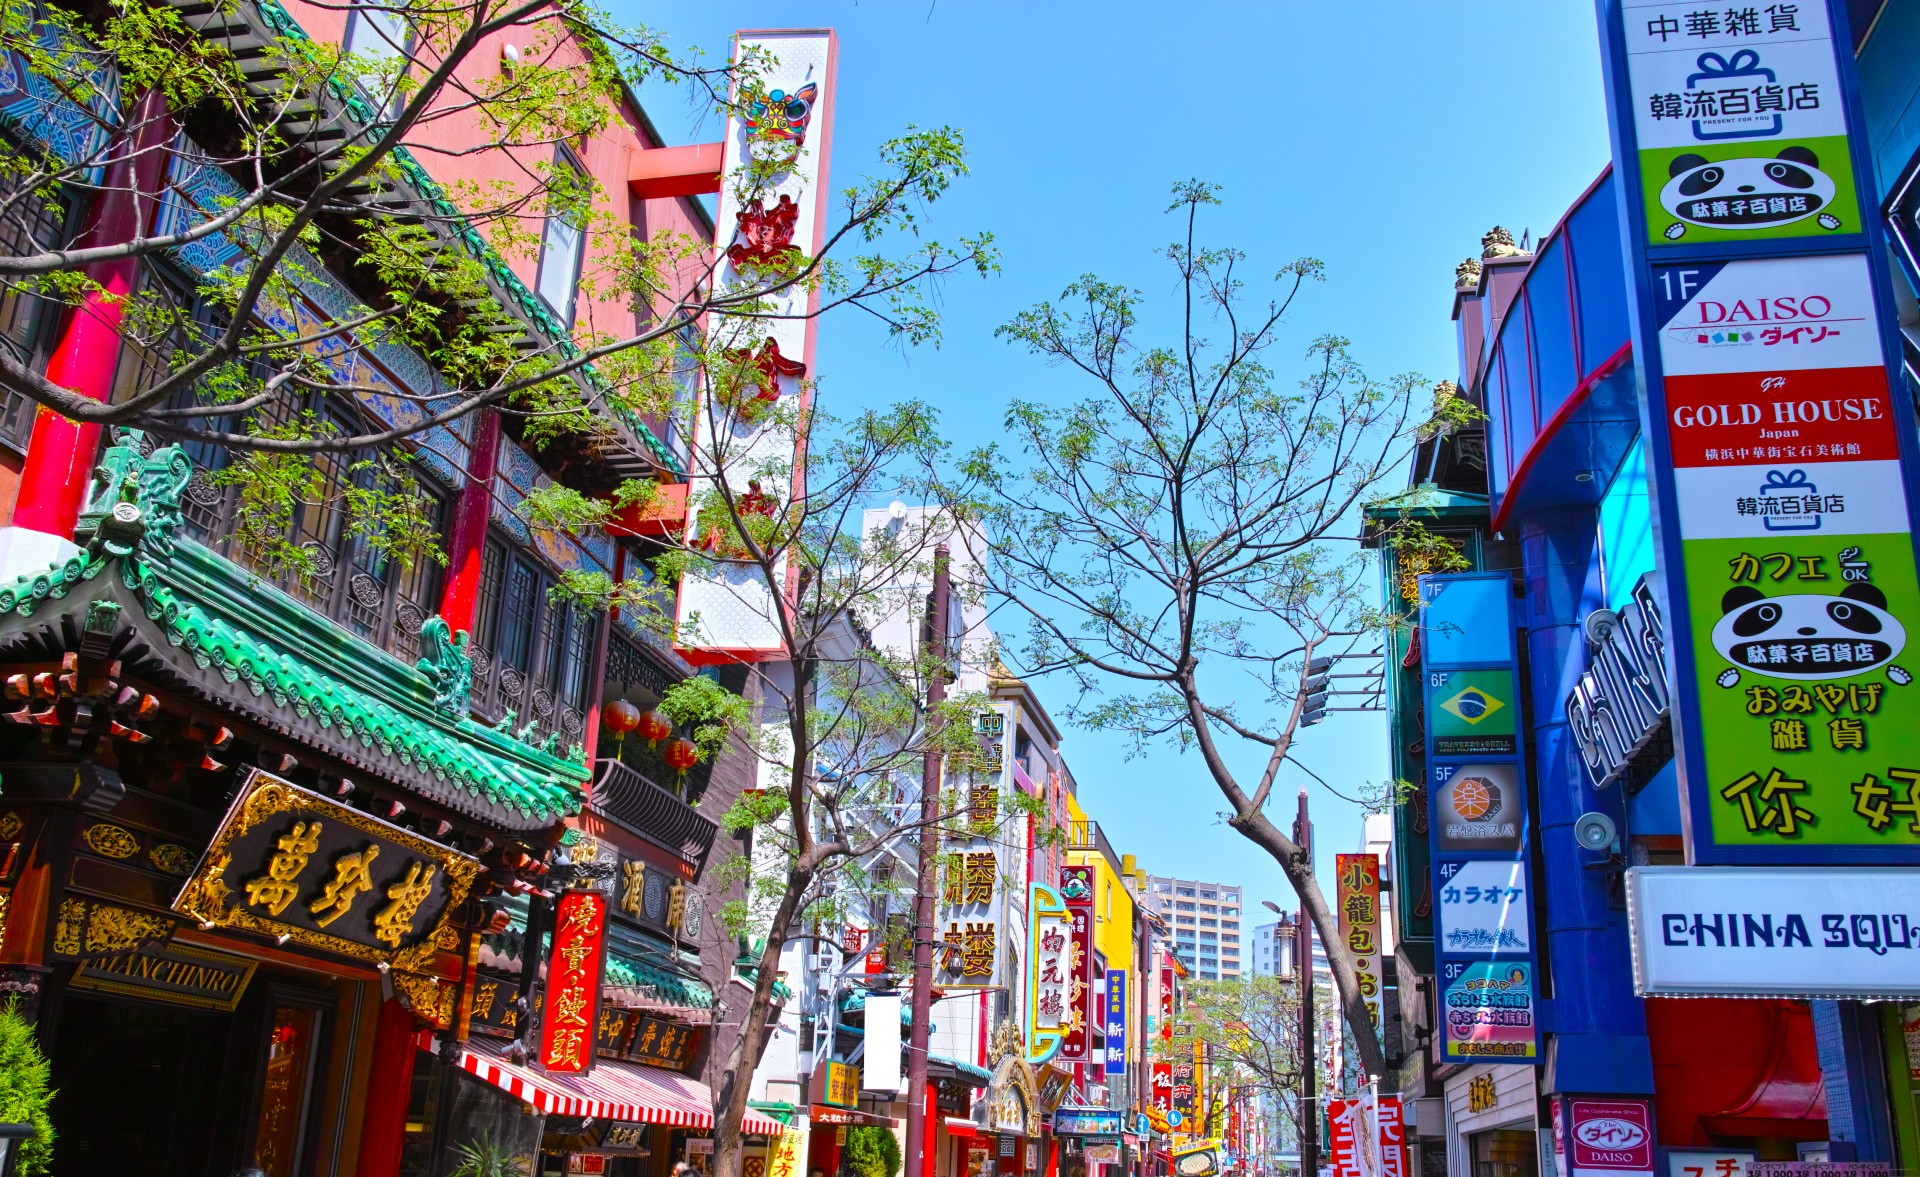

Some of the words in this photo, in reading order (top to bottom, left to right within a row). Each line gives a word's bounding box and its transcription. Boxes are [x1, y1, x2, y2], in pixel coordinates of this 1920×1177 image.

[1647, 4, 1801, 42] 中華雑貨
[1649, 83, 1820, 120] 韓流百貨店
[1691, 196, 1808, 218] 駄菓子百貨店
[1660, 270, 1699, 301] 1F
[1697, 295, 1831, 324] DAISO
[1760, 326, 1841, 346] ダイソー
[1673, 403, 1762, 428] GOLD
[1772, 398, 1883, 423] HOUSE
[1759, 428, 1800, 439] Japan
[1705, 442, 1861, 461] 横浜中華街宝石美術館
[1736, 494, 1845, 516] 韓流百貨店
[1729, 552, 1827, 582] カフェ
[1842, 568, 1868, 581] OK
[1427, 583, 1443, 597] 7F
[1747, 643, 1874, 664] 駄菓子百貨店
[1431, 673, 1448, 687] 6F
[1745, 683, 1882, 716] おみやげ
[1771, 718, 1864, 751] 雑貨
[1436, 767, 1453, 781] 5F
[1440, 863, 1458, 878] 4F
[1443, 886, 1523, 904] カラオケ
[1661, 913, 1814, 948] CHINA
[1822, 913, 1920, 956] SQU
[92, 953, 240, 993] MANCHINRO
[1445, 964, 1463, 978] 3F
[1465, 978, 1511, 991] ヨコハマ
[1448, 993, 1529, 1009] おもしろ水族館
[1449, 1010, 1531, 1026] 赤ちゃん水族館
[1064, 1043, 1081, 1051] 新館
[1107, 1022, 1125, 1062] 新新
[1458, 1043, 1527, 1056] おもしろ商店街
[1585, 1125, 1641, 1142] ダイソー
[1591, 1152, 1633, 1162] DAISO
